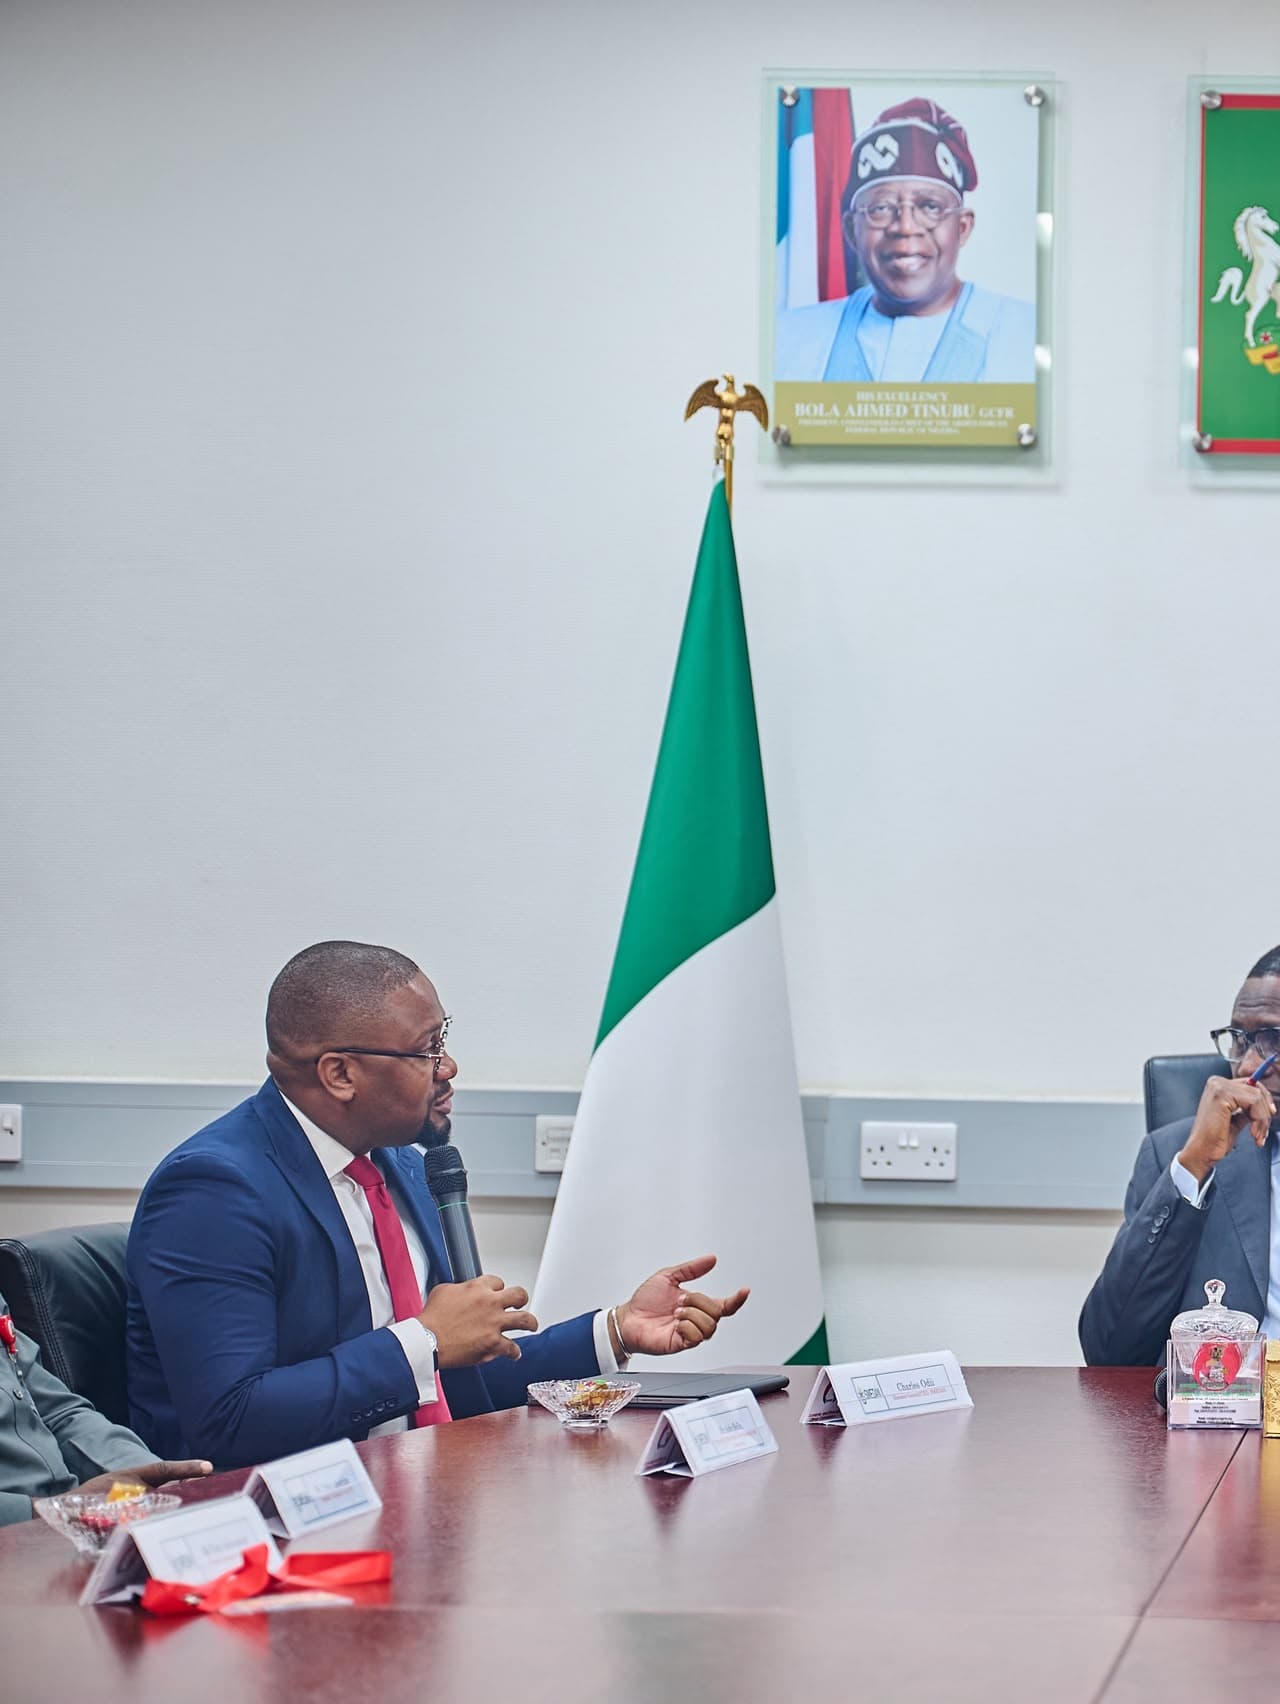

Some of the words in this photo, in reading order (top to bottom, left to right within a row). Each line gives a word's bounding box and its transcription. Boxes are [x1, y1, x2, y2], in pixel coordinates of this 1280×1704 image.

[795, 403, 840, 417] BOLA
[845, 403, 908, 417] AHMED
[912, 403, 975, 417] TINUBU
